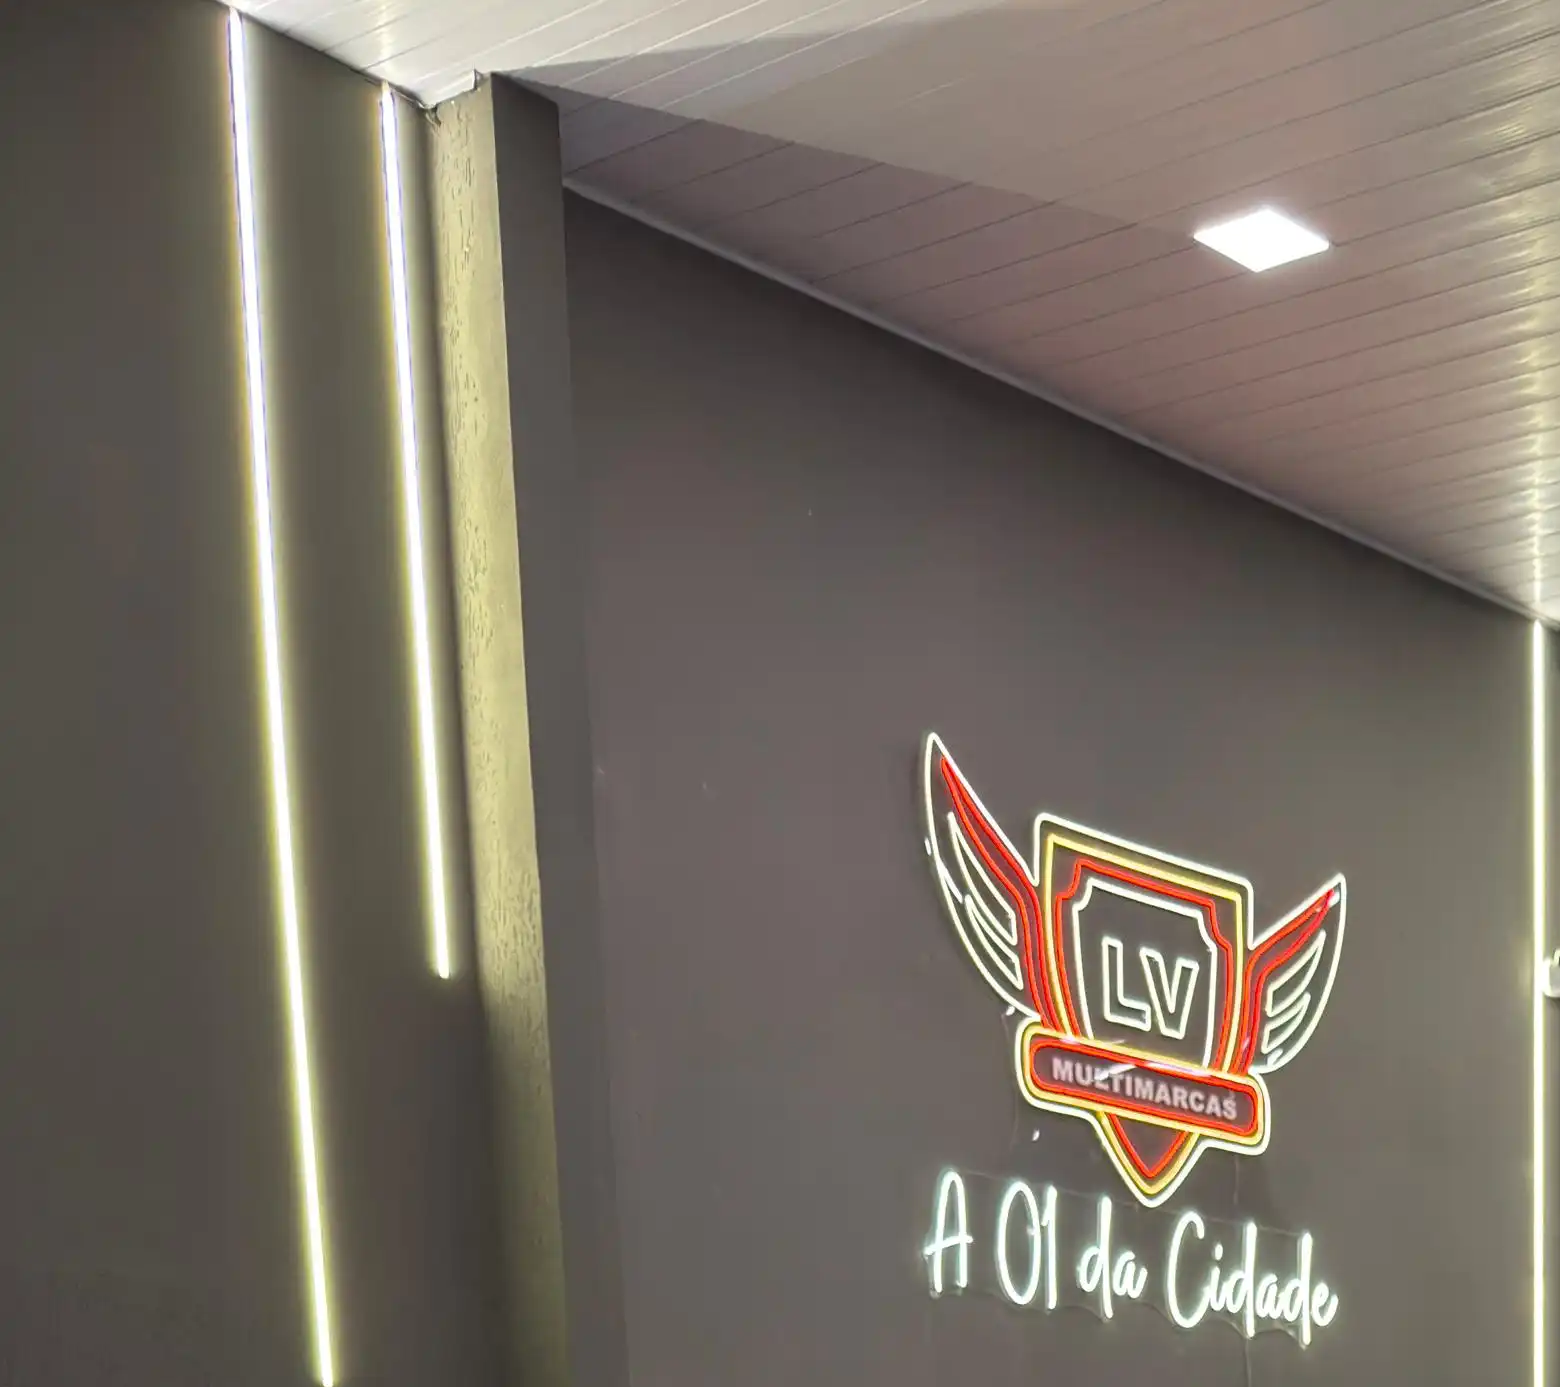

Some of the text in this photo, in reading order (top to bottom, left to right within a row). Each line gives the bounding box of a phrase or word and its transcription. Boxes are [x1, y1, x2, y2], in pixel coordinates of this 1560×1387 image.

[1102, 936, 1199, 1040] LV
[1052, 1057, 1238, 1121] MULTIMARCAS
[924, 1170, 973, 1294] A
[1077, 1195, 1148, 1320] da
[1166, 1210, 1338, 1347] Cidade
